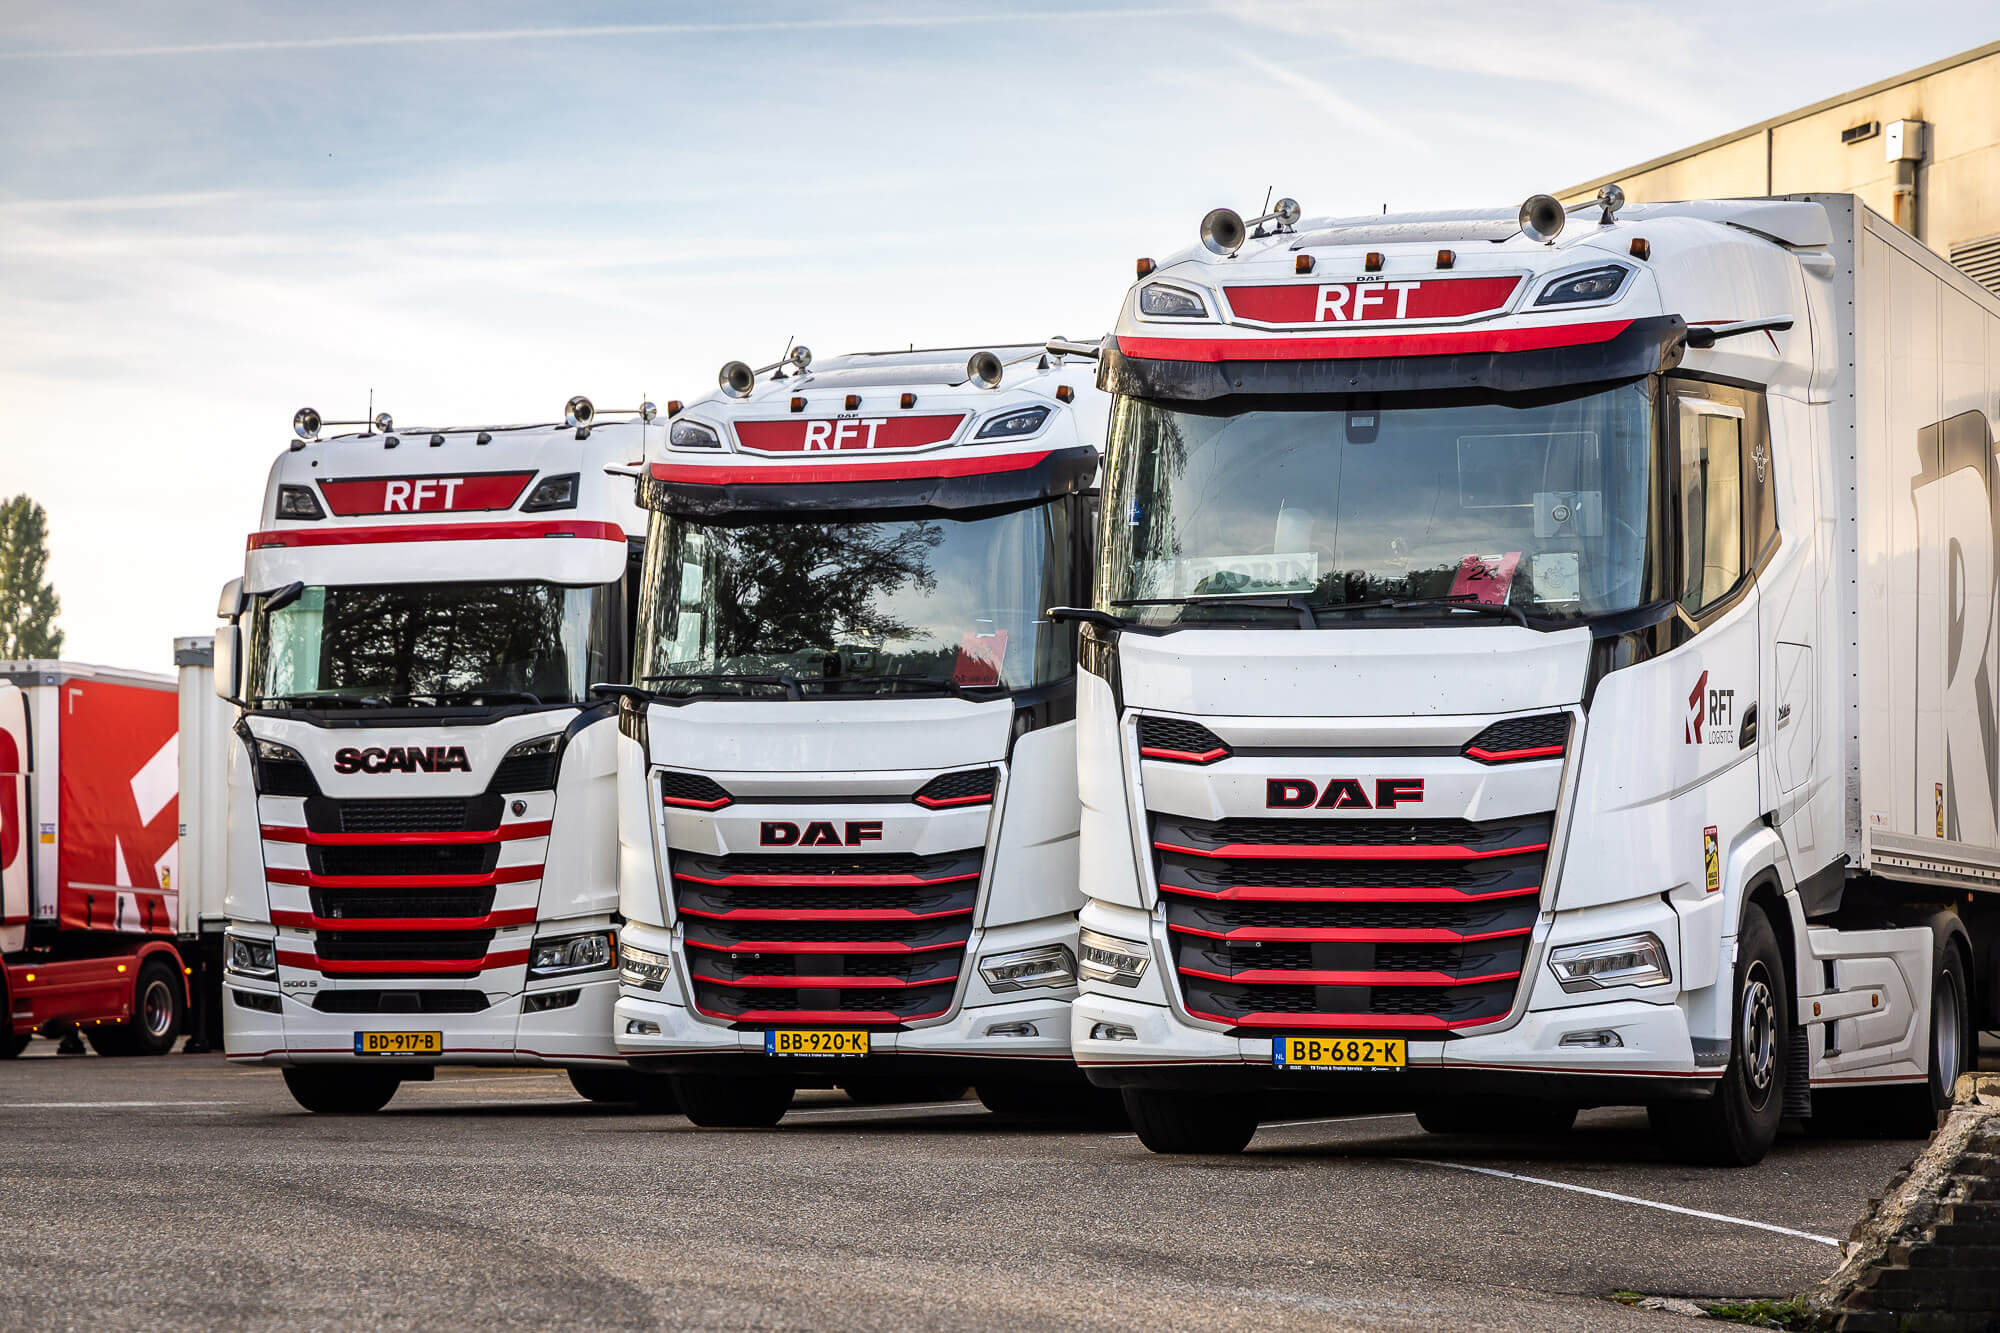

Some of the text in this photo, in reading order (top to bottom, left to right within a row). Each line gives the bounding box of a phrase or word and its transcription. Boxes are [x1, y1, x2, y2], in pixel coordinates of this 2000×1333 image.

[1315, 281, 1421, 321] RFT
[803, 418, 888, 450] RFT
[384, 479, 464, 511] RFT
[1709, 690, 1734, 726] RFT
[1709, 731, 1734, 744] LOGISTICS
[334, 746, 472, 774] SCANIA
[1266, 778, 1424, 809] DAF
[760, 821, 883, 846] DAF
[369, 1035, 433, 1049] BD-917-B
[780, 1033, 862, 1050] BB-920-K
[1293, 1040, 1398, 1063] BB-682-K
